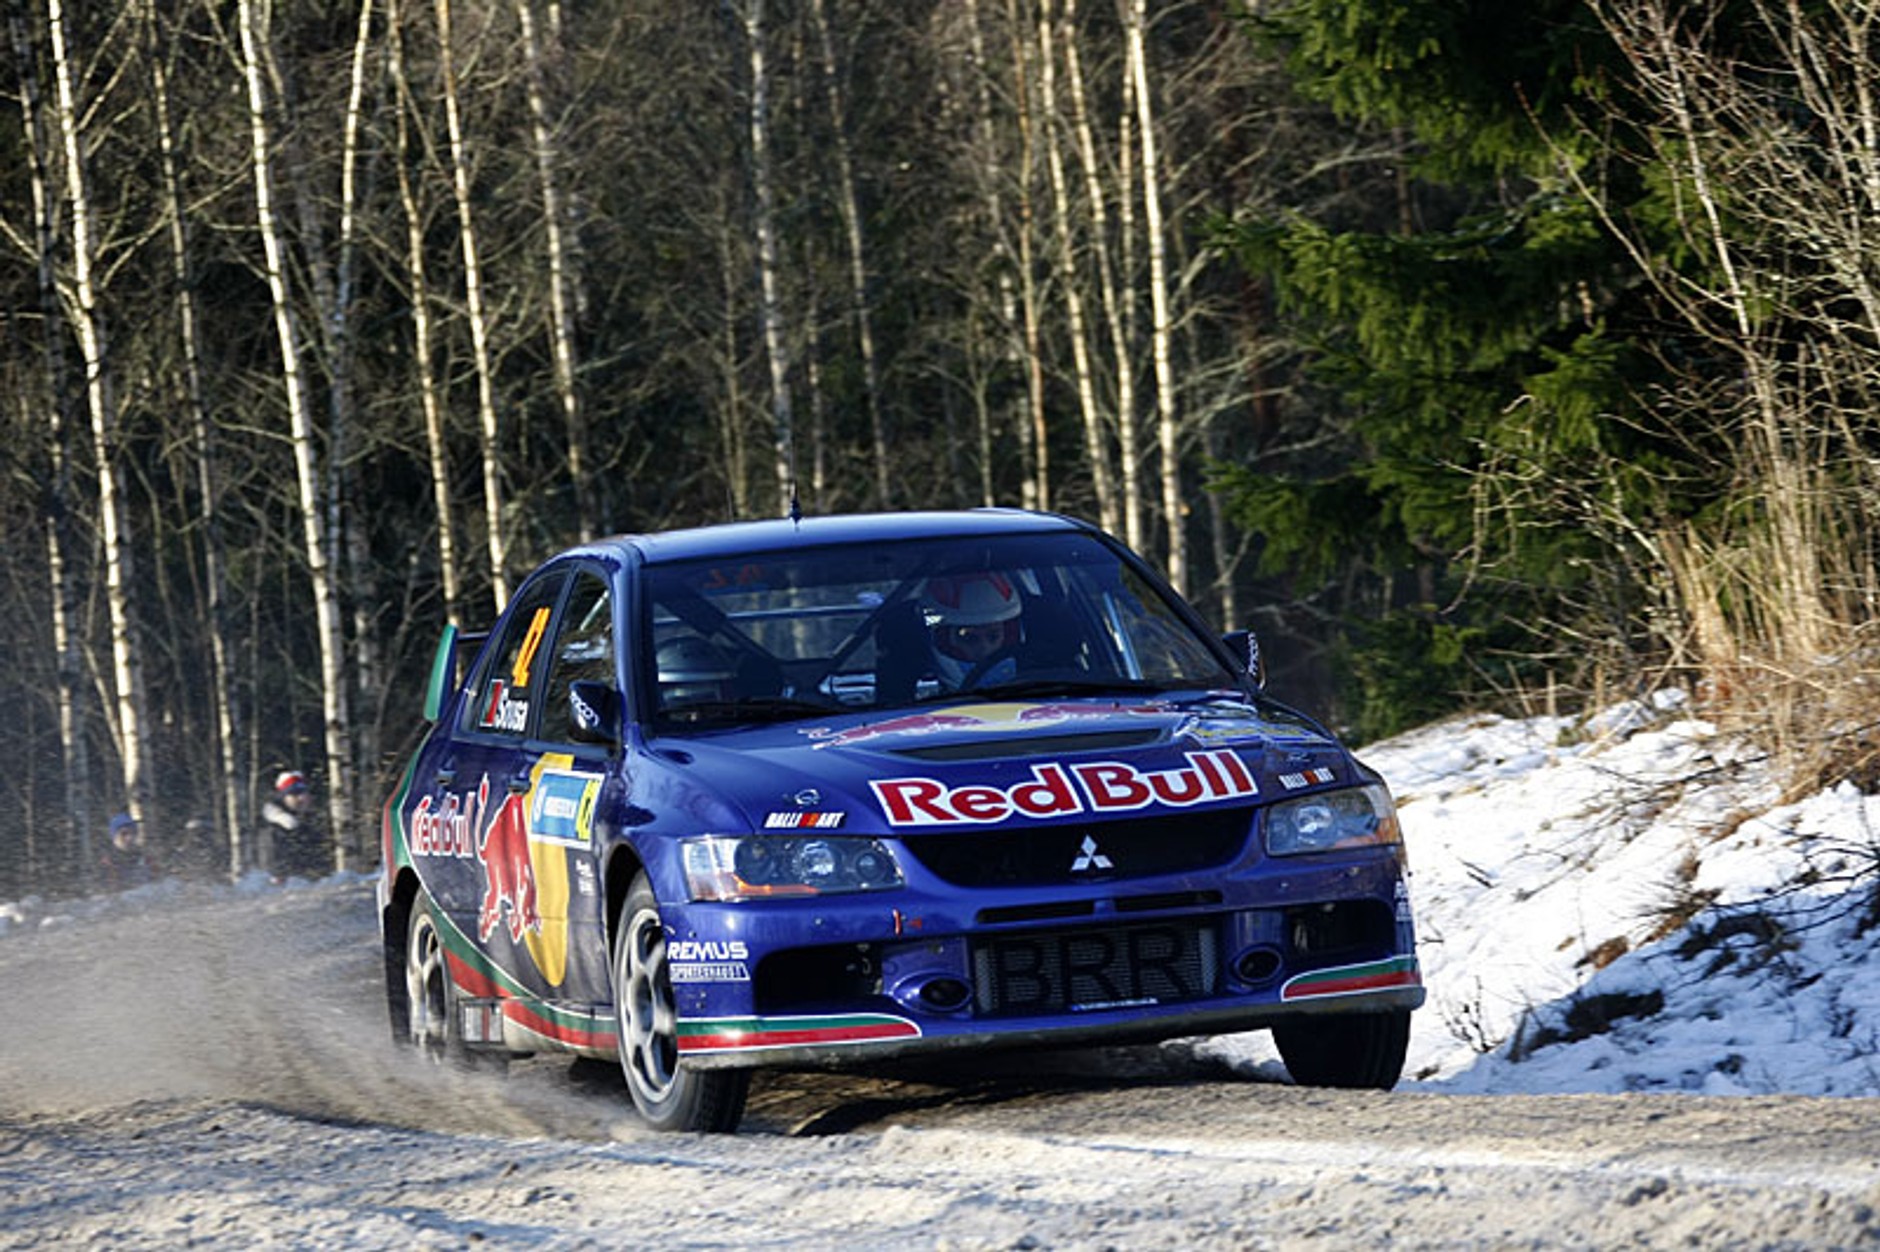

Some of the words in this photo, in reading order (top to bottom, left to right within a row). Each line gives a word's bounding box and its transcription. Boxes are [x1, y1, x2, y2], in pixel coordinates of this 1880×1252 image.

[870, 763, 1084, 825] Red
[1071, 750, 1258, 811] Bull
[667, 941, 749, 961] REMUS
[994, 927, 1195, 1007] BRR
